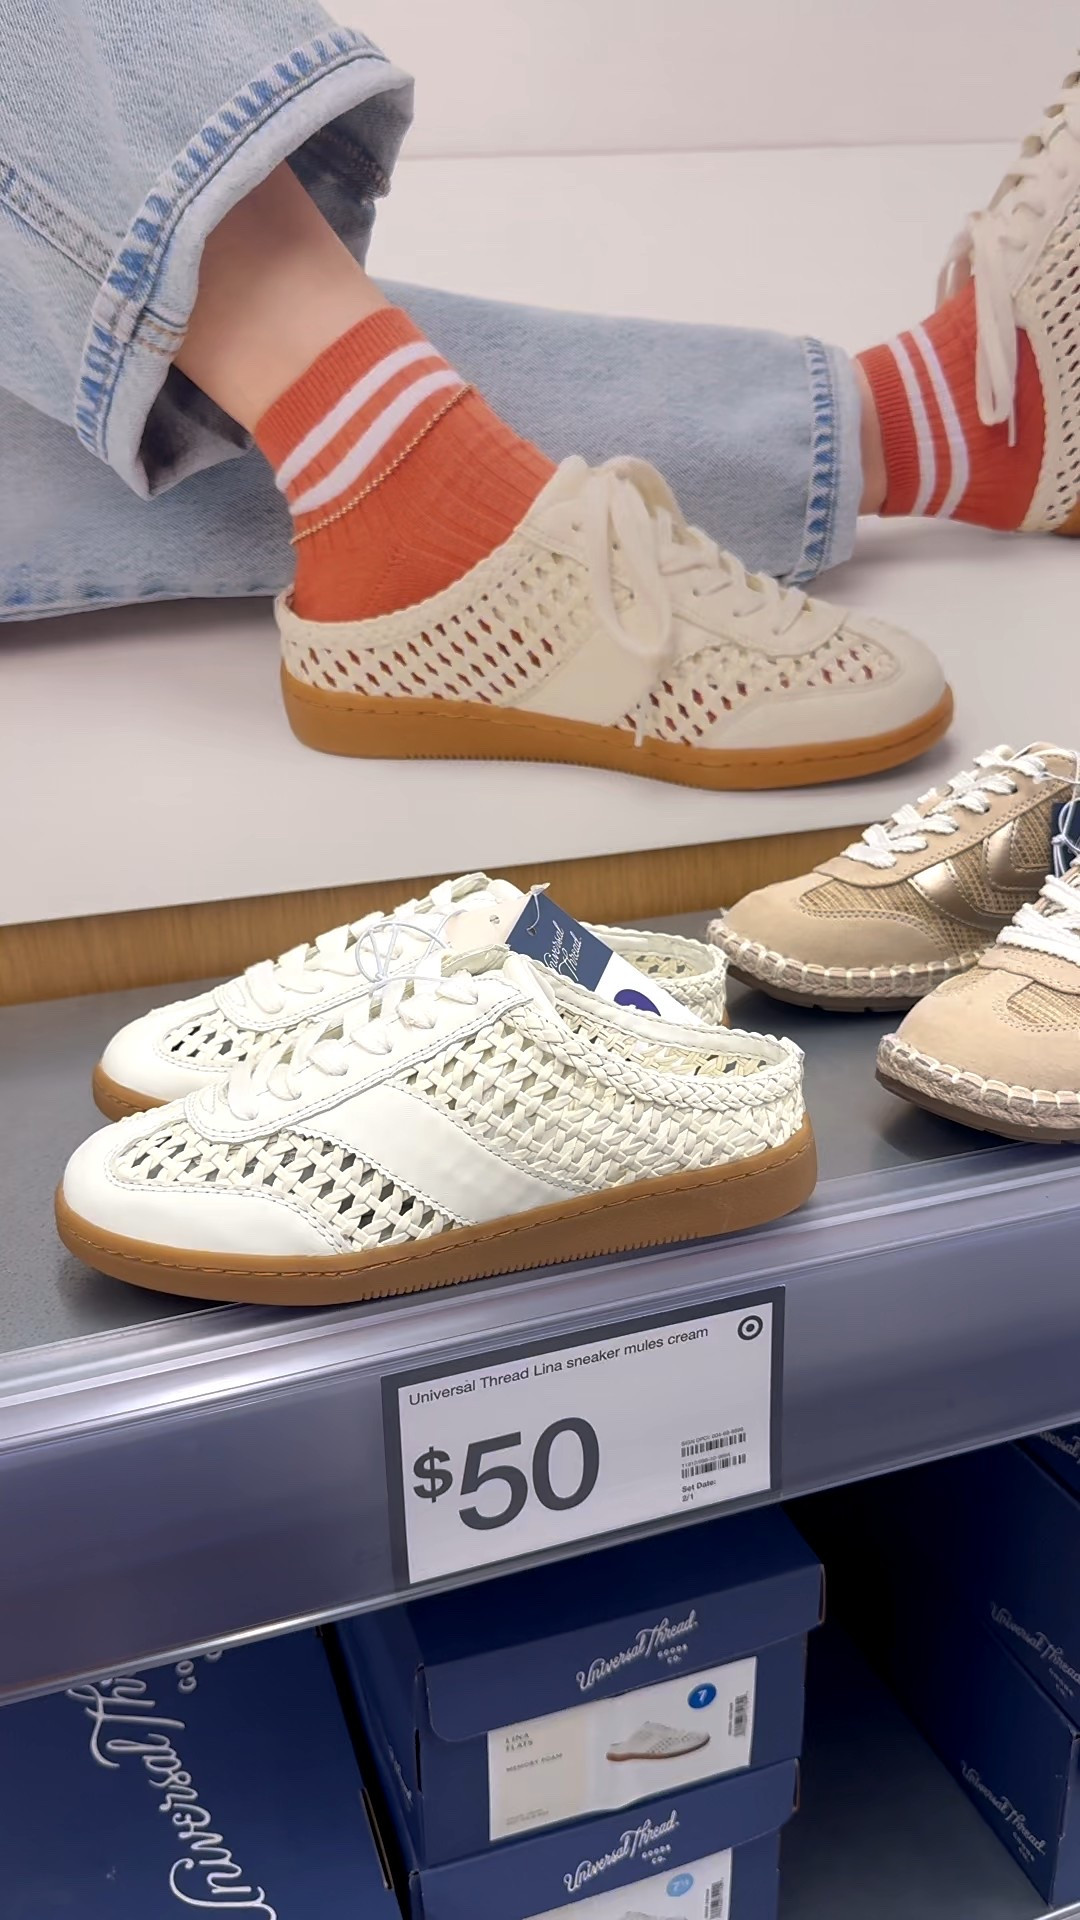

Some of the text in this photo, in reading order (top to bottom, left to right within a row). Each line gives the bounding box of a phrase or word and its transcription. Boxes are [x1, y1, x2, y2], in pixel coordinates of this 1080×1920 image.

[409, 1328, 708, 1405] Universal Thread Lina sneaker mules cream
[682, 1480, 717, 1493] Set Date:
[575, 1608, 698, 1692] Universal Thread
[657, 1642, 689, 1659] GOODS
[697, 1689, 708, 1705] 7
[563, 1809, 680, 1893] Universal Thread
[641, 1843, 672, 1860] GOODS
